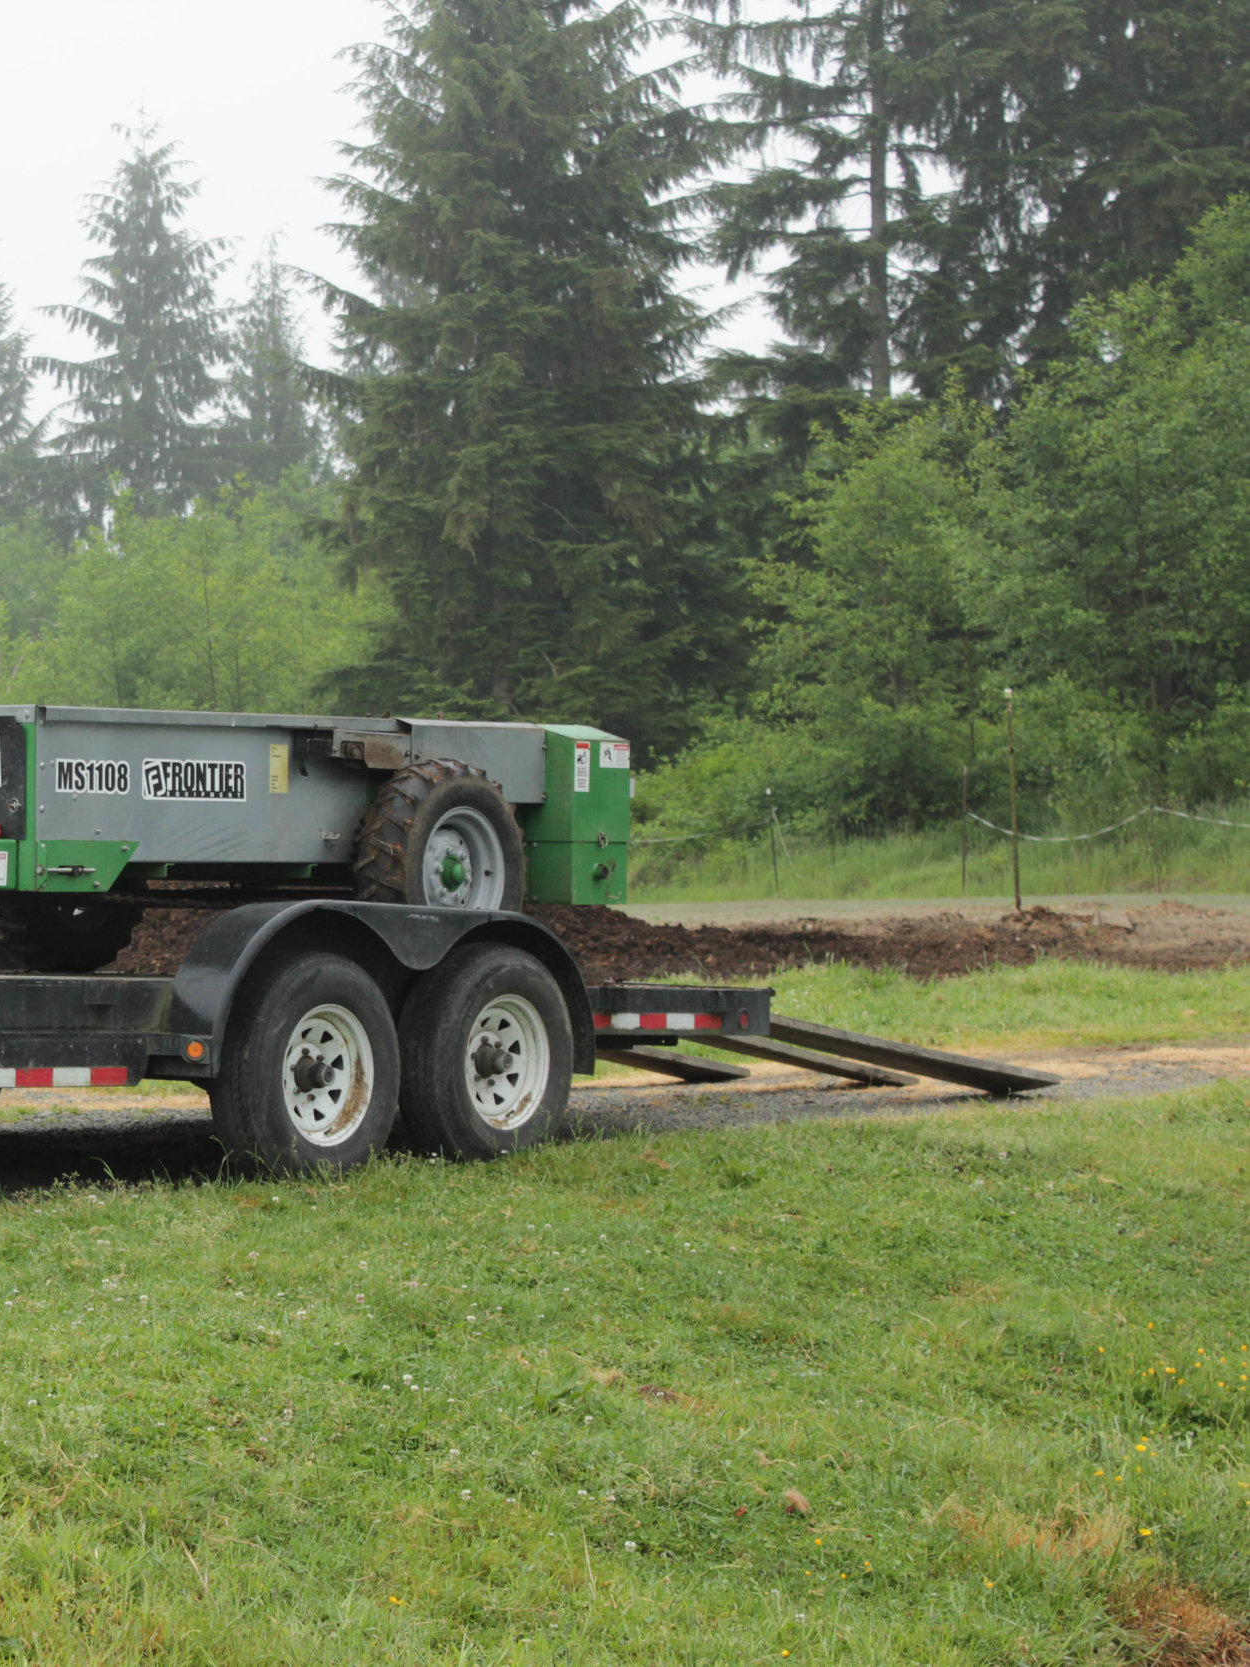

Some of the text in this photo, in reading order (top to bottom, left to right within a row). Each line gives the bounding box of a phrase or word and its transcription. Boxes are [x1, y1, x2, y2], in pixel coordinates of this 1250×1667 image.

[57, 761, 128, 792] MS1108
[161, 761, 245, 793] FRONTIER
[166, 791, 242, 799] EQUIPMENT
